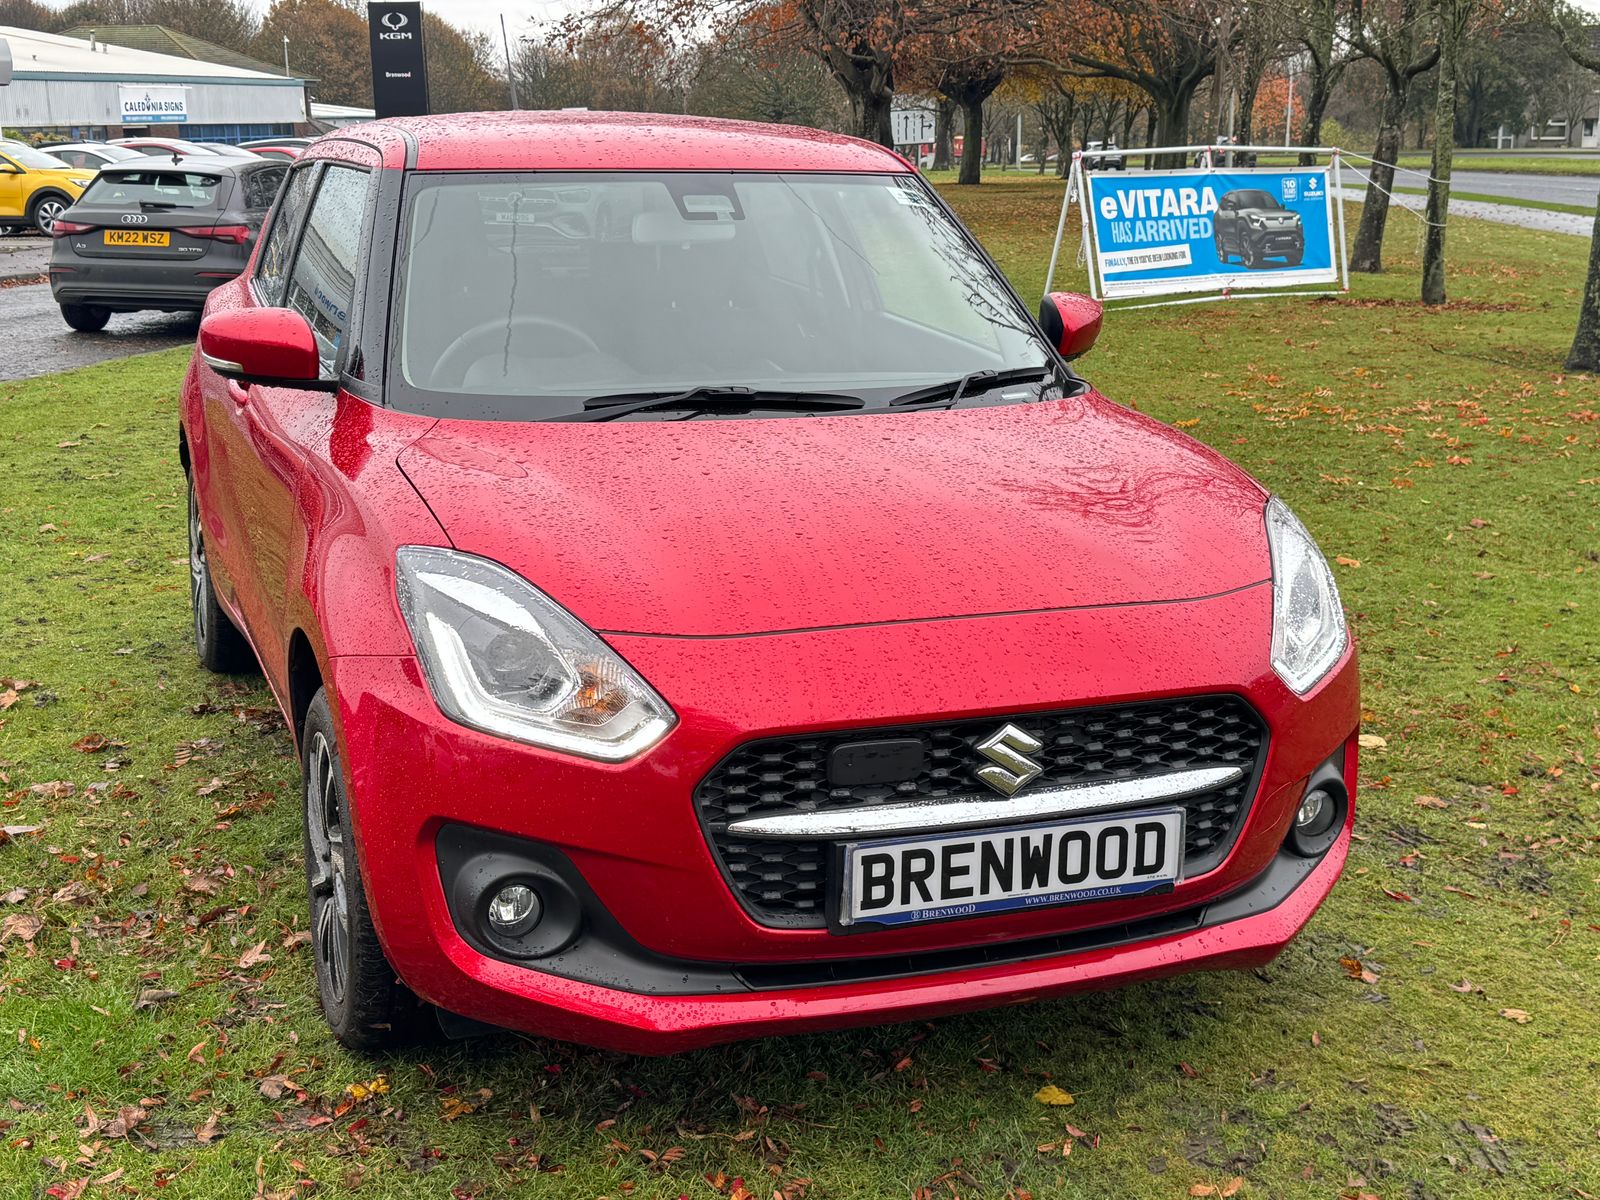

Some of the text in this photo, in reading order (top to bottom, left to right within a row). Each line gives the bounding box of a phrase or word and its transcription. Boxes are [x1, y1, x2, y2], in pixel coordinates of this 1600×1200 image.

[379, 32, 413, 40] KGM
[124, 100, 184, 112] CALEDONIA SIGNS
[1111, 217, 1213, 244] HAS ARRIVED
[109, 231, 165, 244] KM22 WSZ
[1104, 256, 1127, 268] FINALLY,
[860, 822, 1167, 910] BRENWOOD
[1024, 886, 1123, 906] WWW.BRENWOOD.CO.UK
